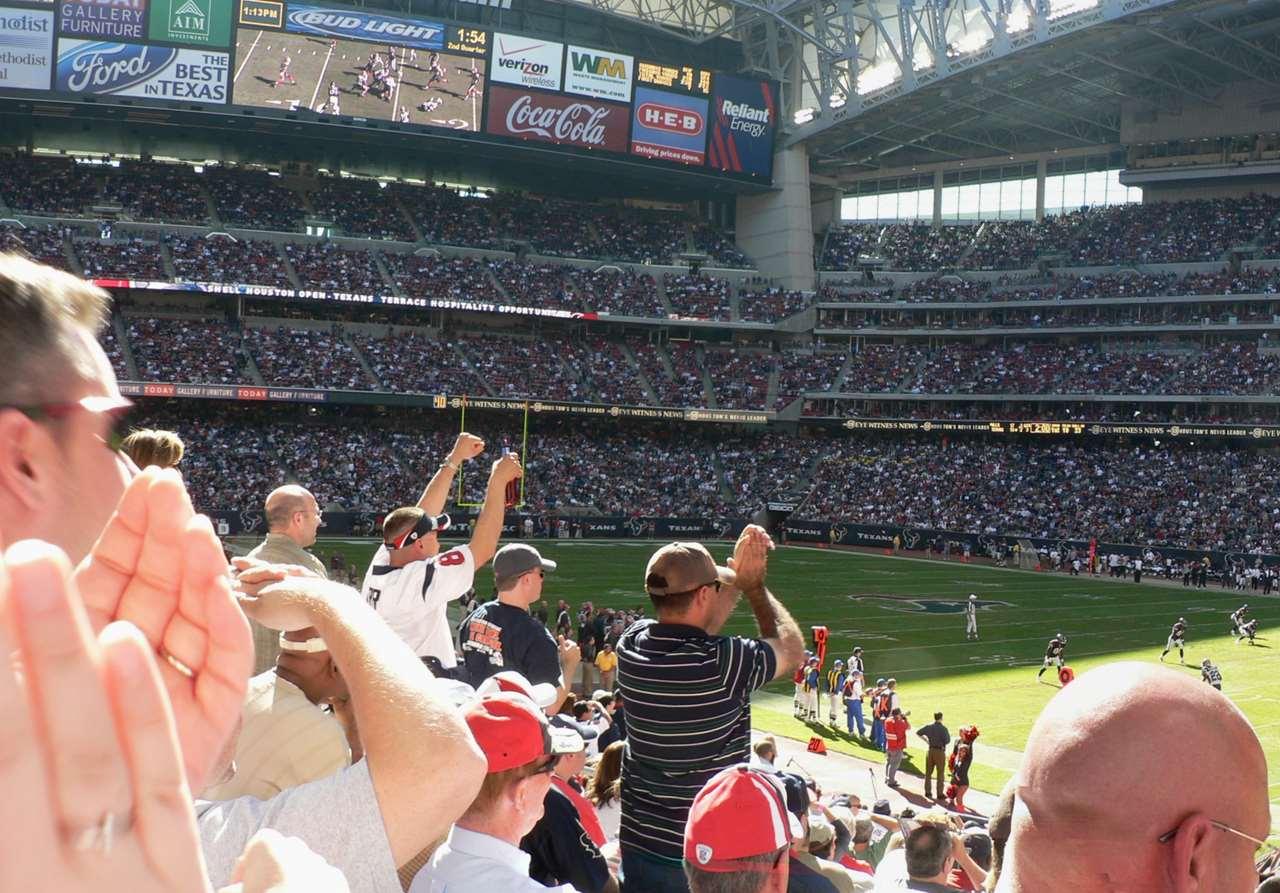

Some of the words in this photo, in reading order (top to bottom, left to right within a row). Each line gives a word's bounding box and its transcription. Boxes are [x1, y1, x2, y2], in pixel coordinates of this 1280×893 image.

[62, 4, 143, 22] GALLERY
[61, 19, 142, 38] FURNITURE
[173, 16, 204, 30] AIM
[305, 13, 362, 29] BUD
[364, 20, 440, 40] LIGHT
[457, 29, 486, 44] 1:54
[68, 44, 150, 92] Ford
[202, 54, 227, 66] THE
[498, 57, 549, 75] verizon
[571, 51, 627, 80] WM
[176, 63, 227, 82] BEST
[144, 84, 158, 95] IN
[158, 80, 225, 101] TEXAS
[506, 95, 610, 145] Coca-Cola
[722, 100, 770, 123] Reliant
[635, 145, 659, 157] Driving
[660, 150, 681, 160] prices
[207, 284, 241, 294] SHELL
[246, 286, 294, 297] HOUSTON
[299, 290, 326, 300] OPEN
[334, 292, 374, 303] TEXANS
[381, 295, 426, 307] TERRACE
[430, 299, 495, 312] HOSPITALITY
[144, 384, 174, 395] TODAY
[238, 389, 267, 400] TODAY
[768, 503, 795, 512] GEICO
[787, 527, 822, 536] TEXANS
[857, 532, 894, 542] TEXANS
